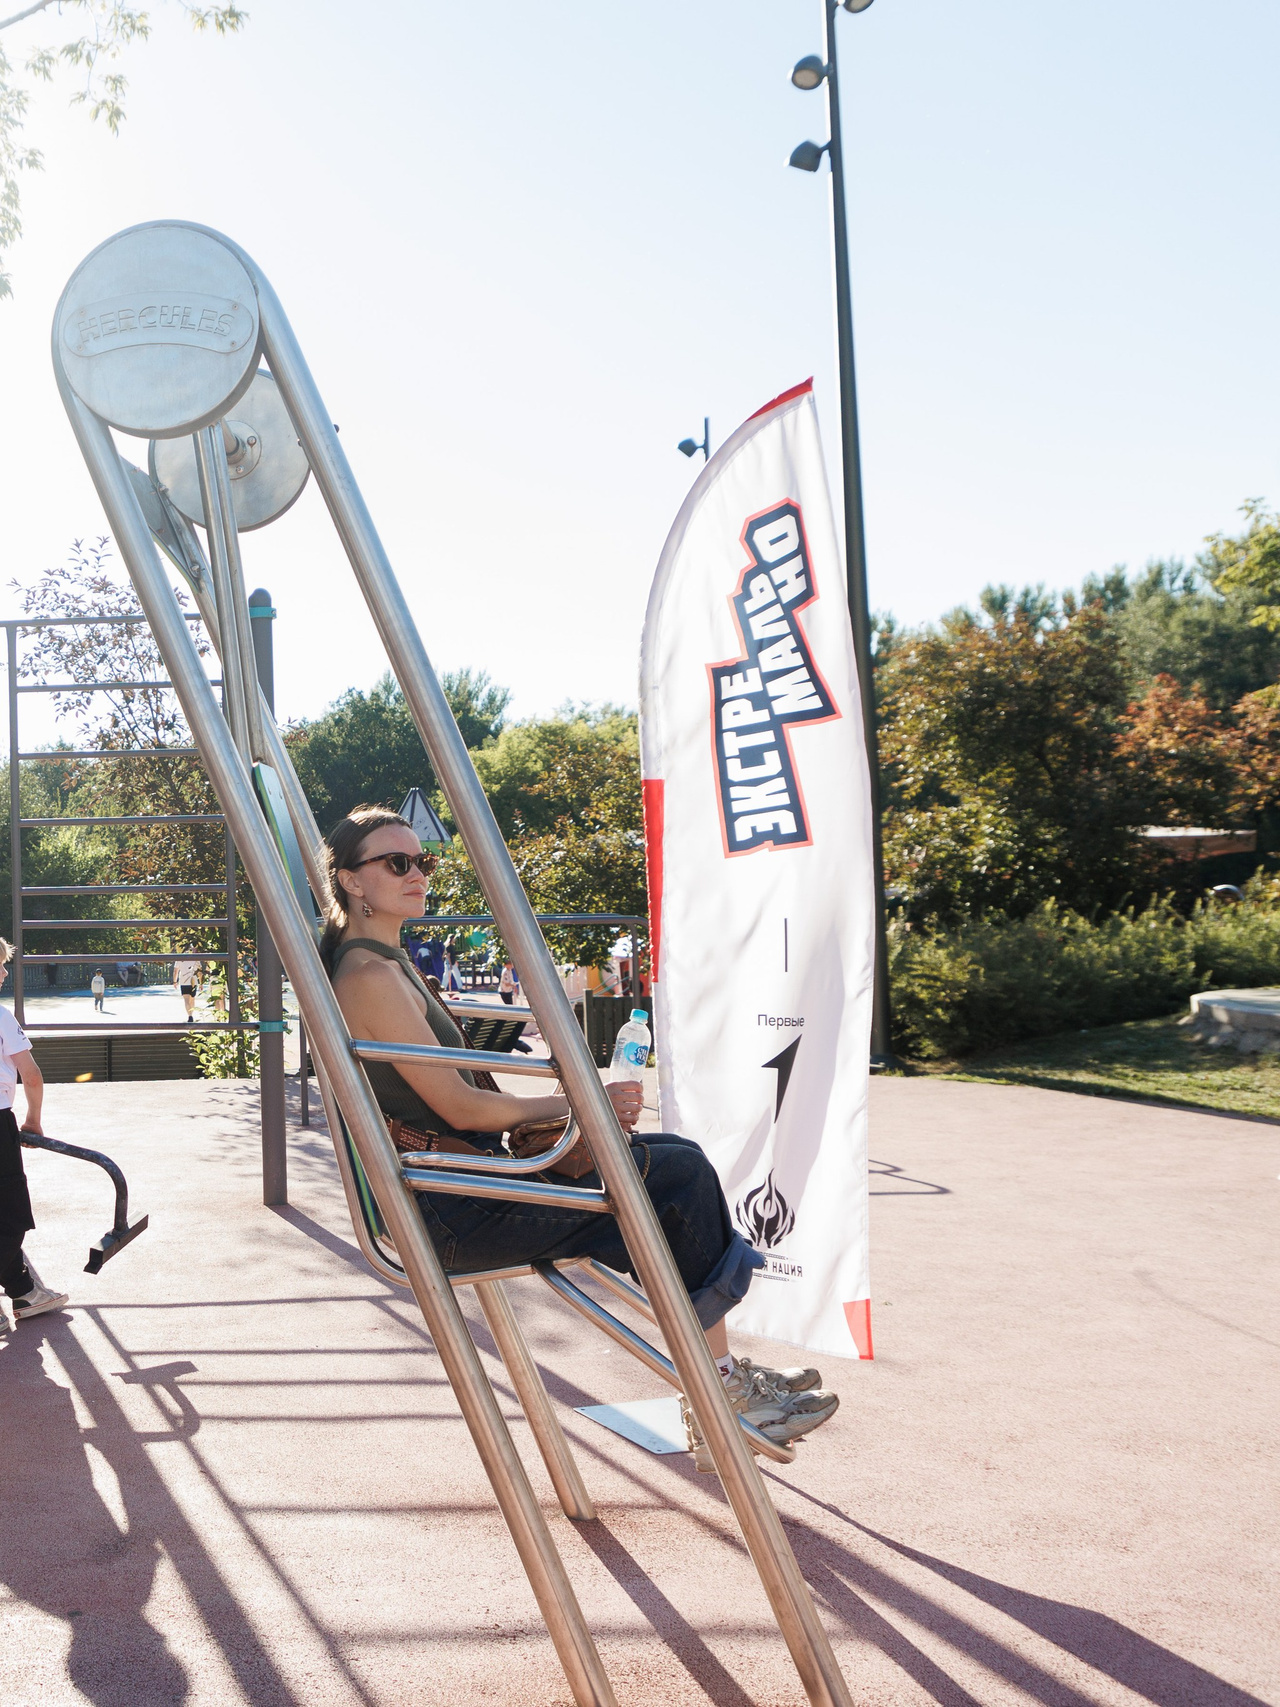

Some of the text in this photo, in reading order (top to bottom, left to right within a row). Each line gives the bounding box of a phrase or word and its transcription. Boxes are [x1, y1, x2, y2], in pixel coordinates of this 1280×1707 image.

[77, 305, 235, 343] HERCULES
[758, 1014, 805, 1030] Первые
[772, 1261, 803, 1277] НАЦИЯ
